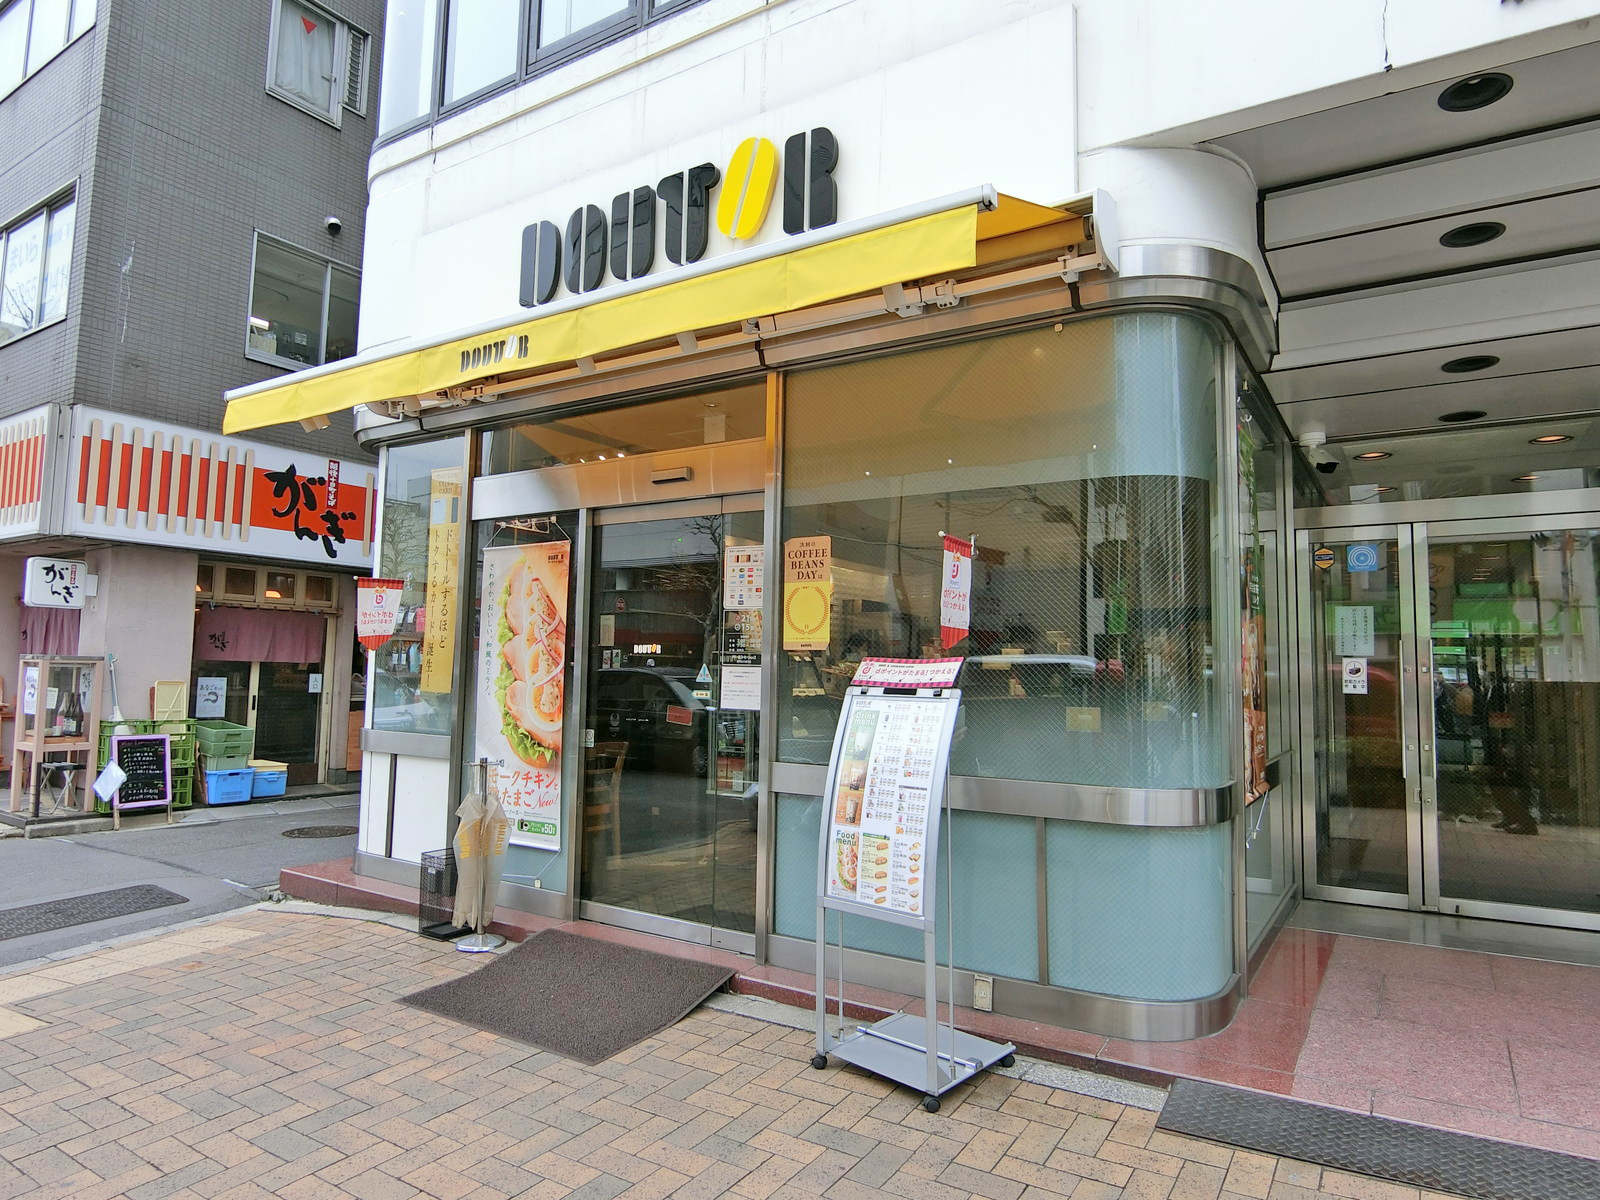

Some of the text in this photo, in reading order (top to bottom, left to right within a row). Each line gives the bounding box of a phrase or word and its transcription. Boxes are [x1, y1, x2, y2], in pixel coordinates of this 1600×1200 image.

[519, 127, 839, 308] DOUTOR
[460, 335, 529, 373] DOUTOR
[263, 463, 356, 558] がんぎ
[788, 549, 828, 560] COFFEE
[791, 559, 825, 570] BEANS
[439, 529, 453, 649] ドトールするほど
[634, 643, 661, 653] DOUTOR
[856, 711, 876, 720] Drink
[836, 829, 855, 840] Food
[835, 837, 857, 846] menu
